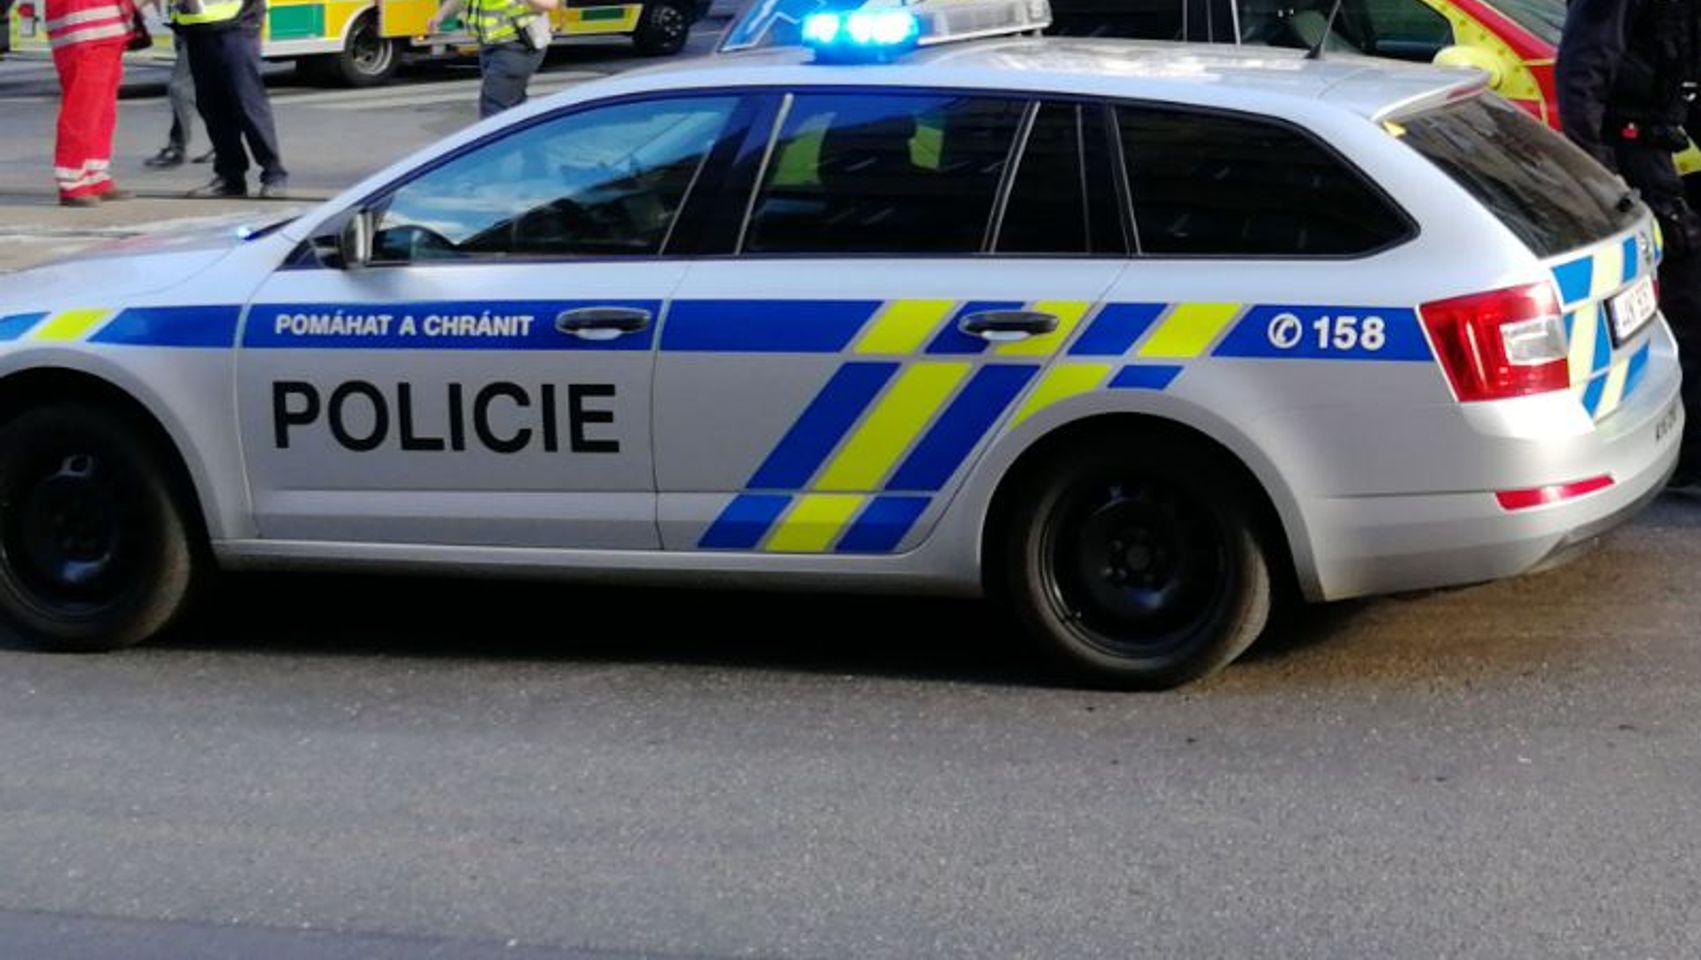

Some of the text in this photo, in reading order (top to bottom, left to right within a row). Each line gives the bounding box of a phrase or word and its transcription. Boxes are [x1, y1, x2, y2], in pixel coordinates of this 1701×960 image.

[274, 309, 535, 337] POMÁHAT A CHRÁNIT
[1312, 315, 1386, 351] 158
[272, 379, 620, 454] POLICIE
